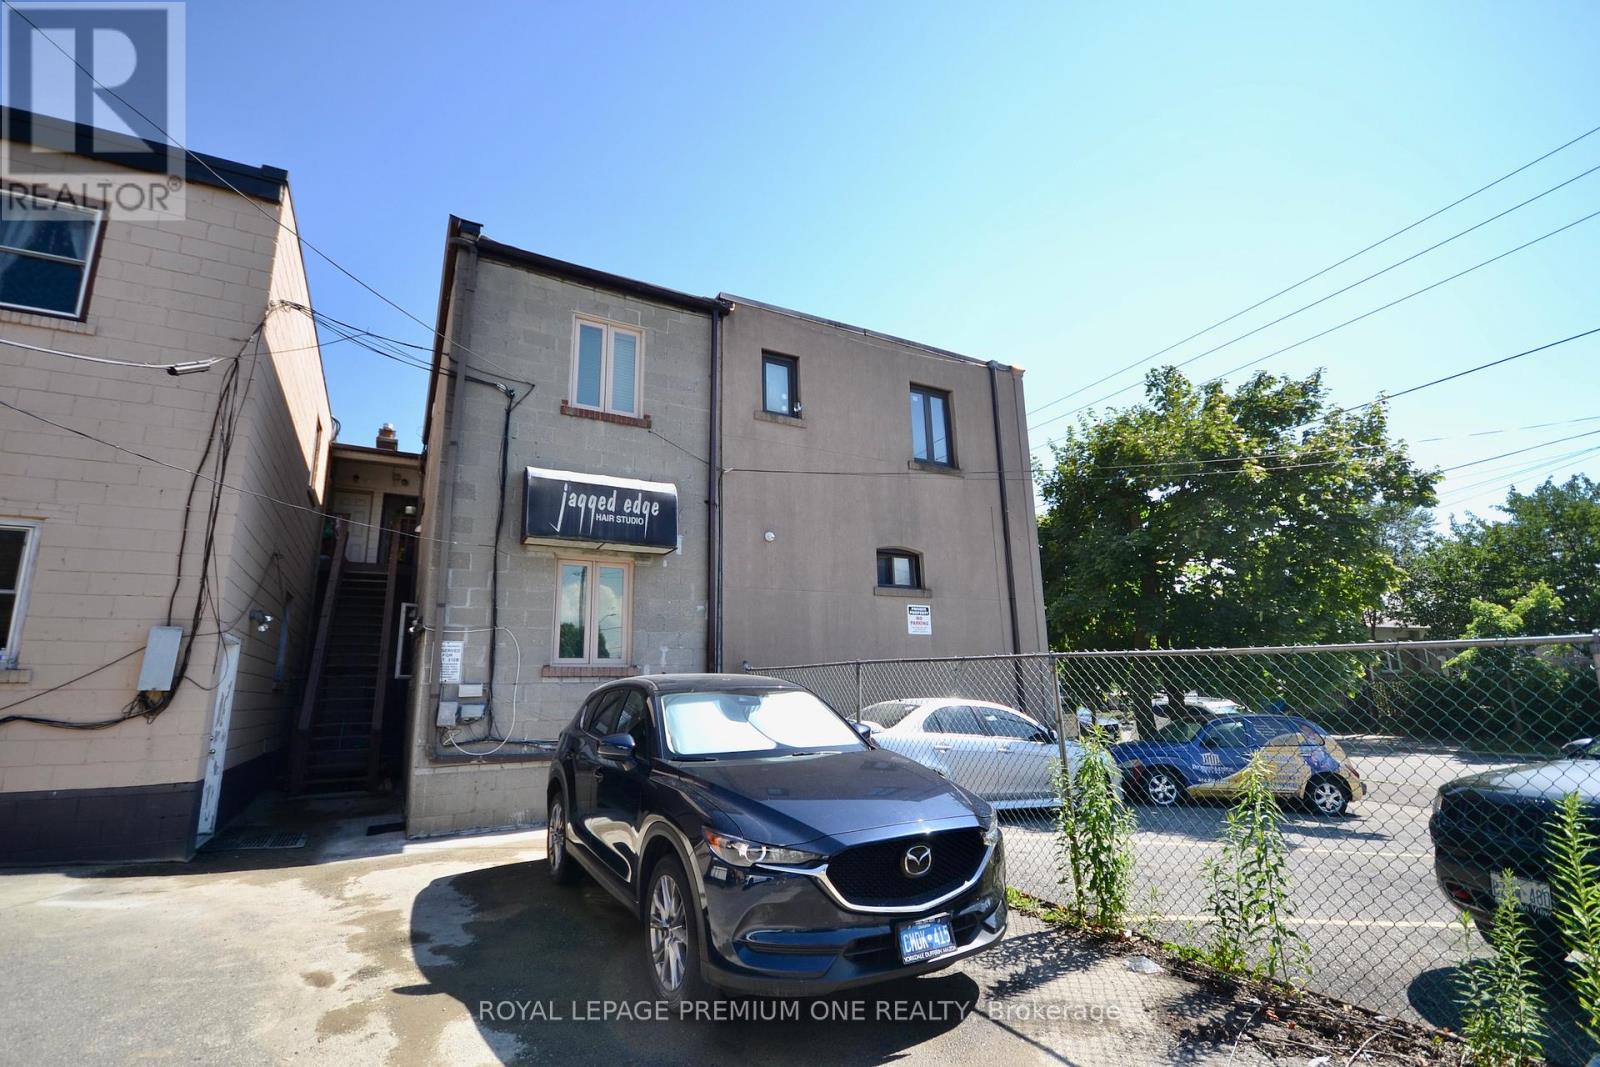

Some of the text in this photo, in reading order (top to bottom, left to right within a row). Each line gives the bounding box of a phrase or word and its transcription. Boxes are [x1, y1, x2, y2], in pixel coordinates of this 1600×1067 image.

[549, 483, 660, 540] jagged edge
[595, 513, 644, 526] HAIR STUDIO
